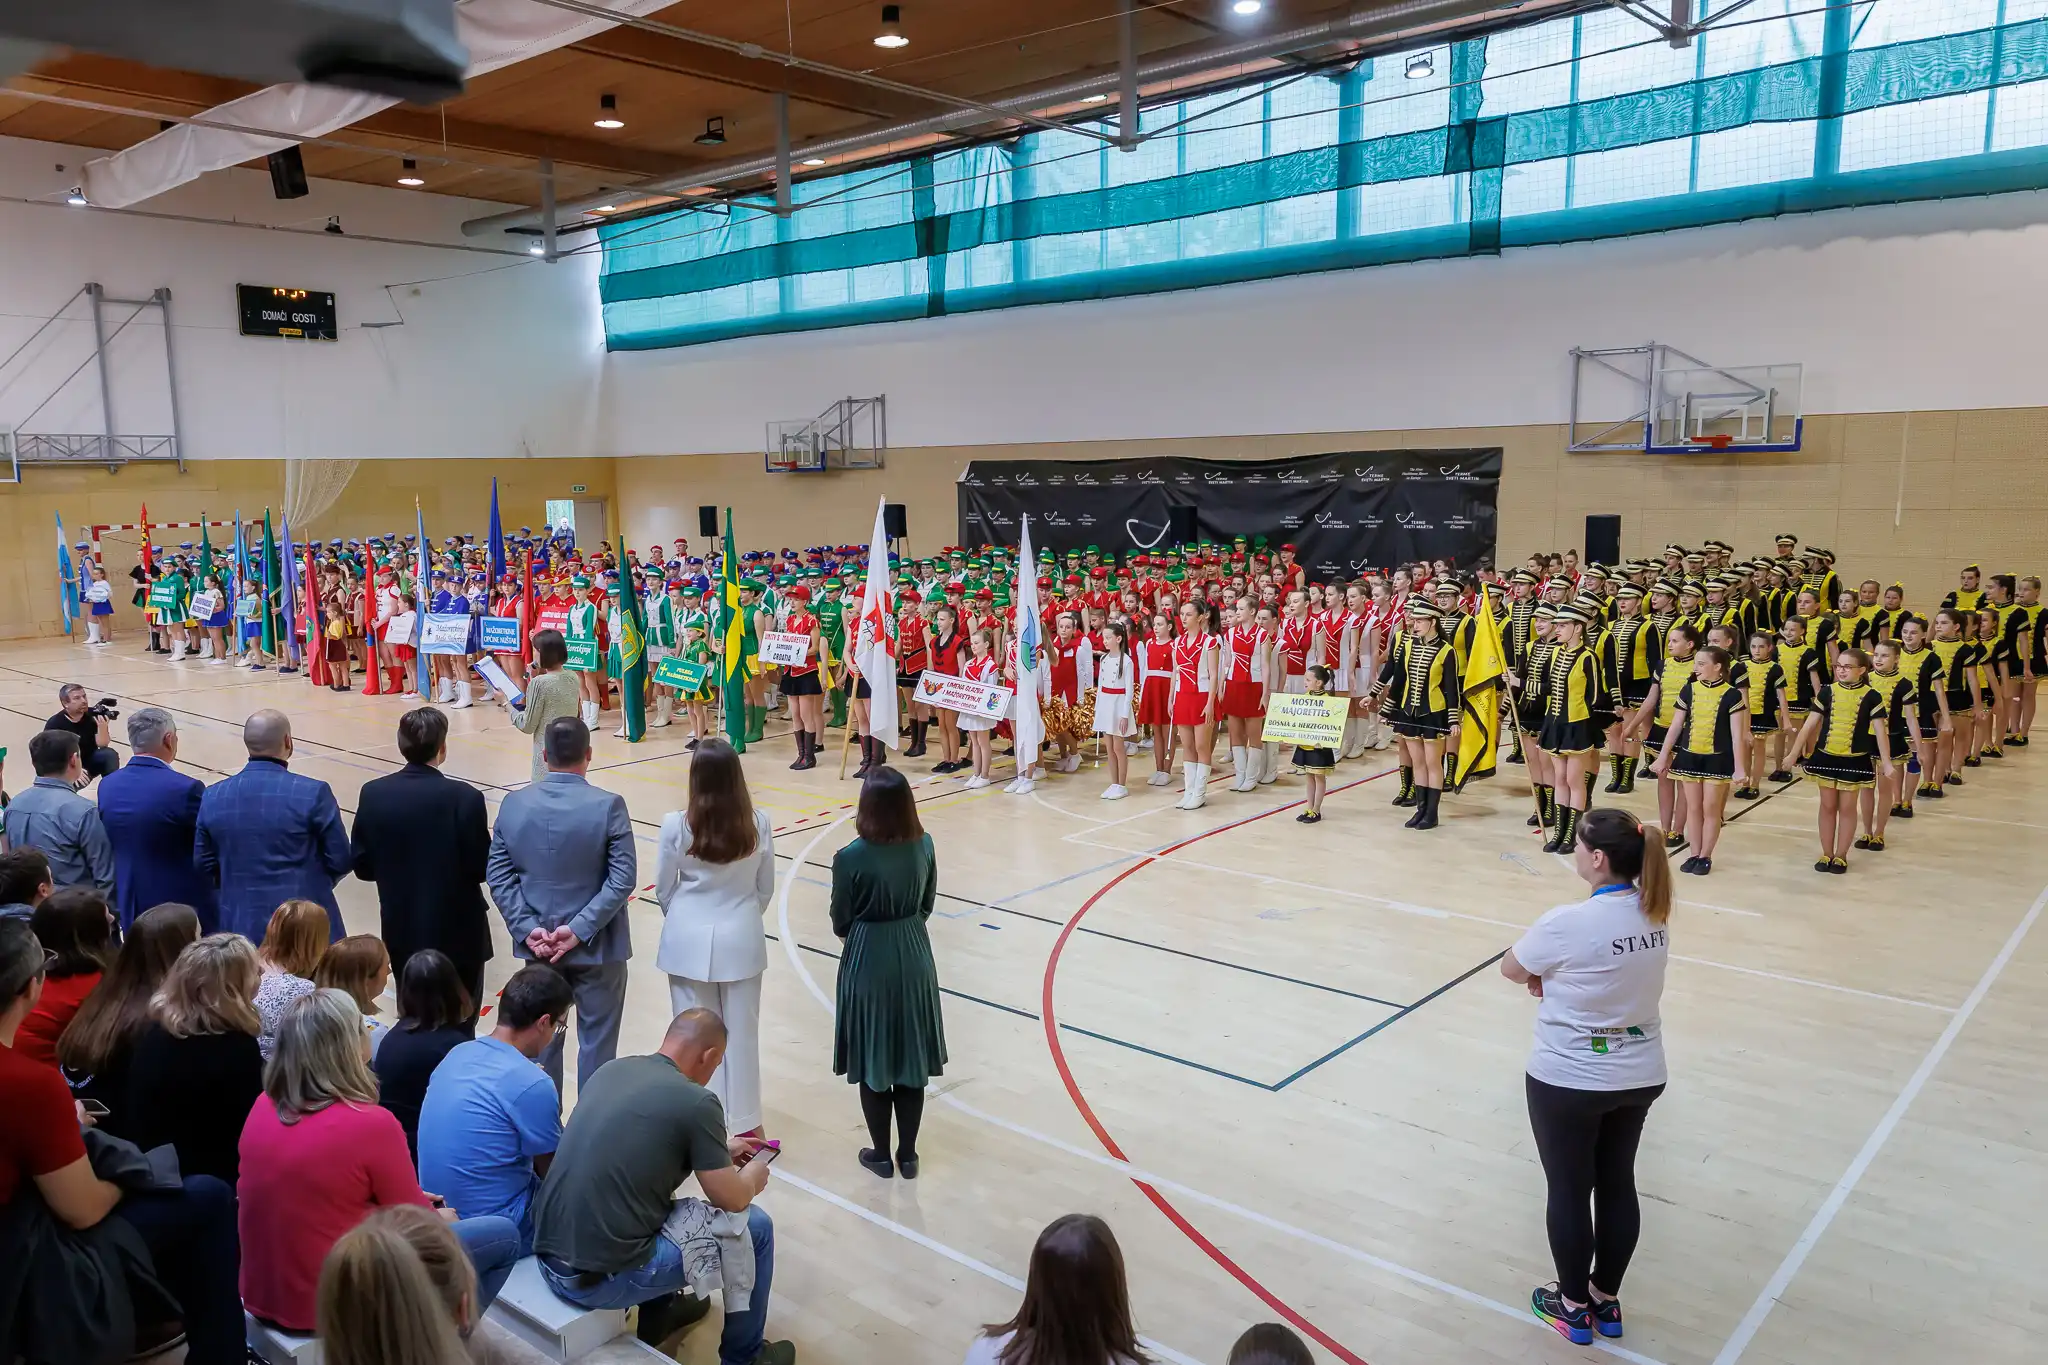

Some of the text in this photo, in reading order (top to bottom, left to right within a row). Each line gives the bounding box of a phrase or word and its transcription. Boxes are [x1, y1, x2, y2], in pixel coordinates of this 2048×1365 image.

[292, 312, 316, 324] GOSTI
[1291, 698, 1324, 707] MOSTAR
[1281, 707, 1330, 718] MAJORETTES
[1299, 722, 1342, 731] HERZEGOVINA
[1612, 930, 1664, 956] STAFF
